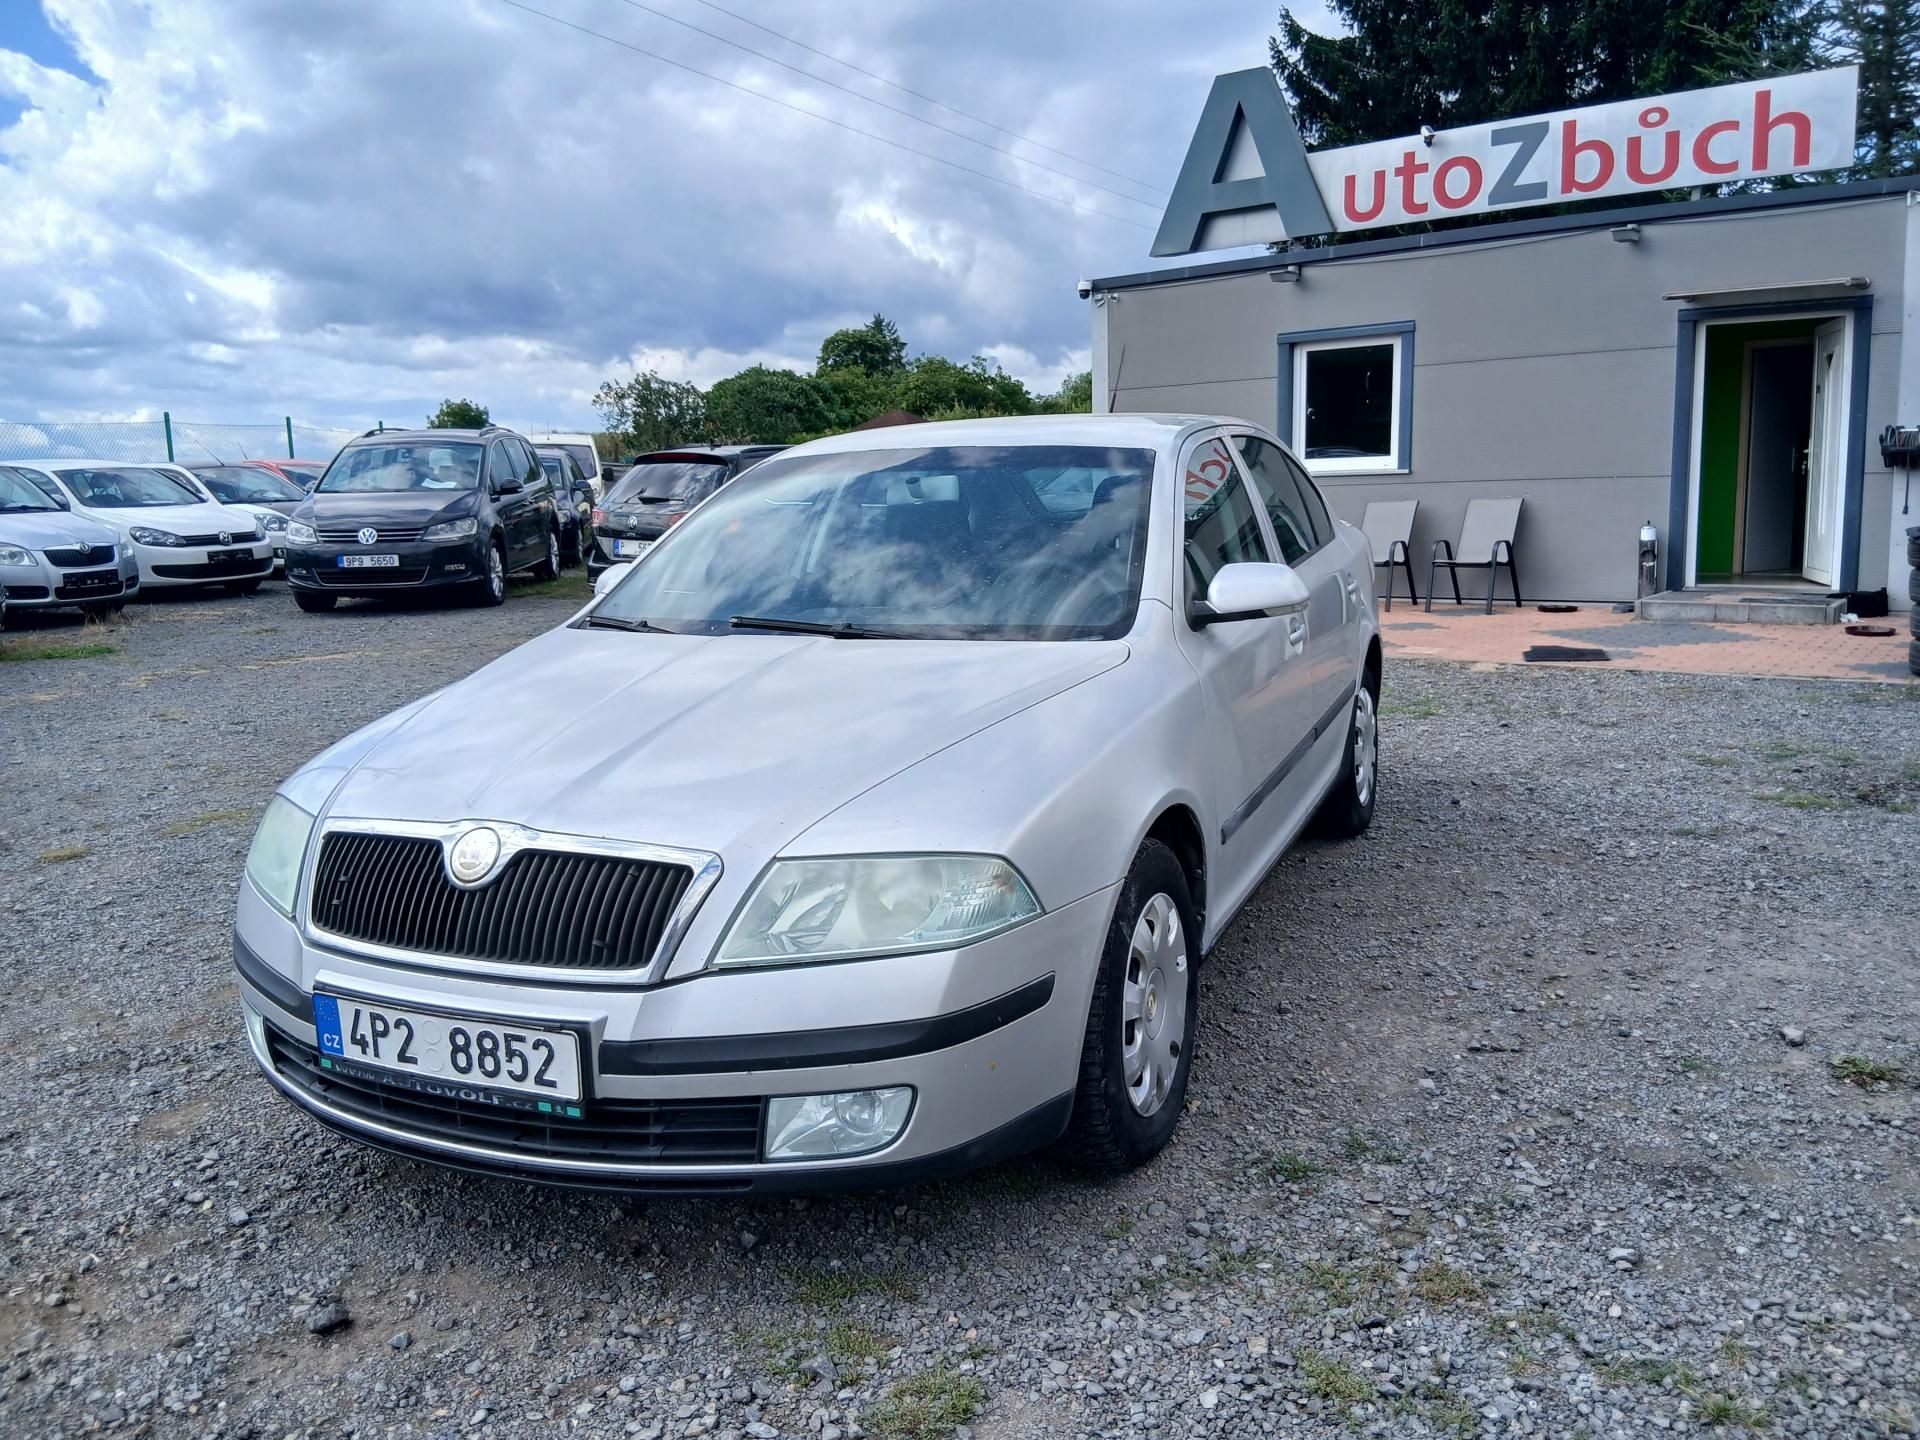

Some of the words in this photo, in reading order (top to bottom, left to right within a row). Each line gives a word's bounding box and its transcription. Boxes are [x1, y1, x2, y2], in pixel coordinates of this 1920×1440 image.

[345, 556, 364, 567] 9P9
[370, 556, 395, 566] 5650
[323, 1033, 341, 1049] CZ
[350, 1007, 418, 1066] 4P2
[449, 1026, 557, 1089] 8852
